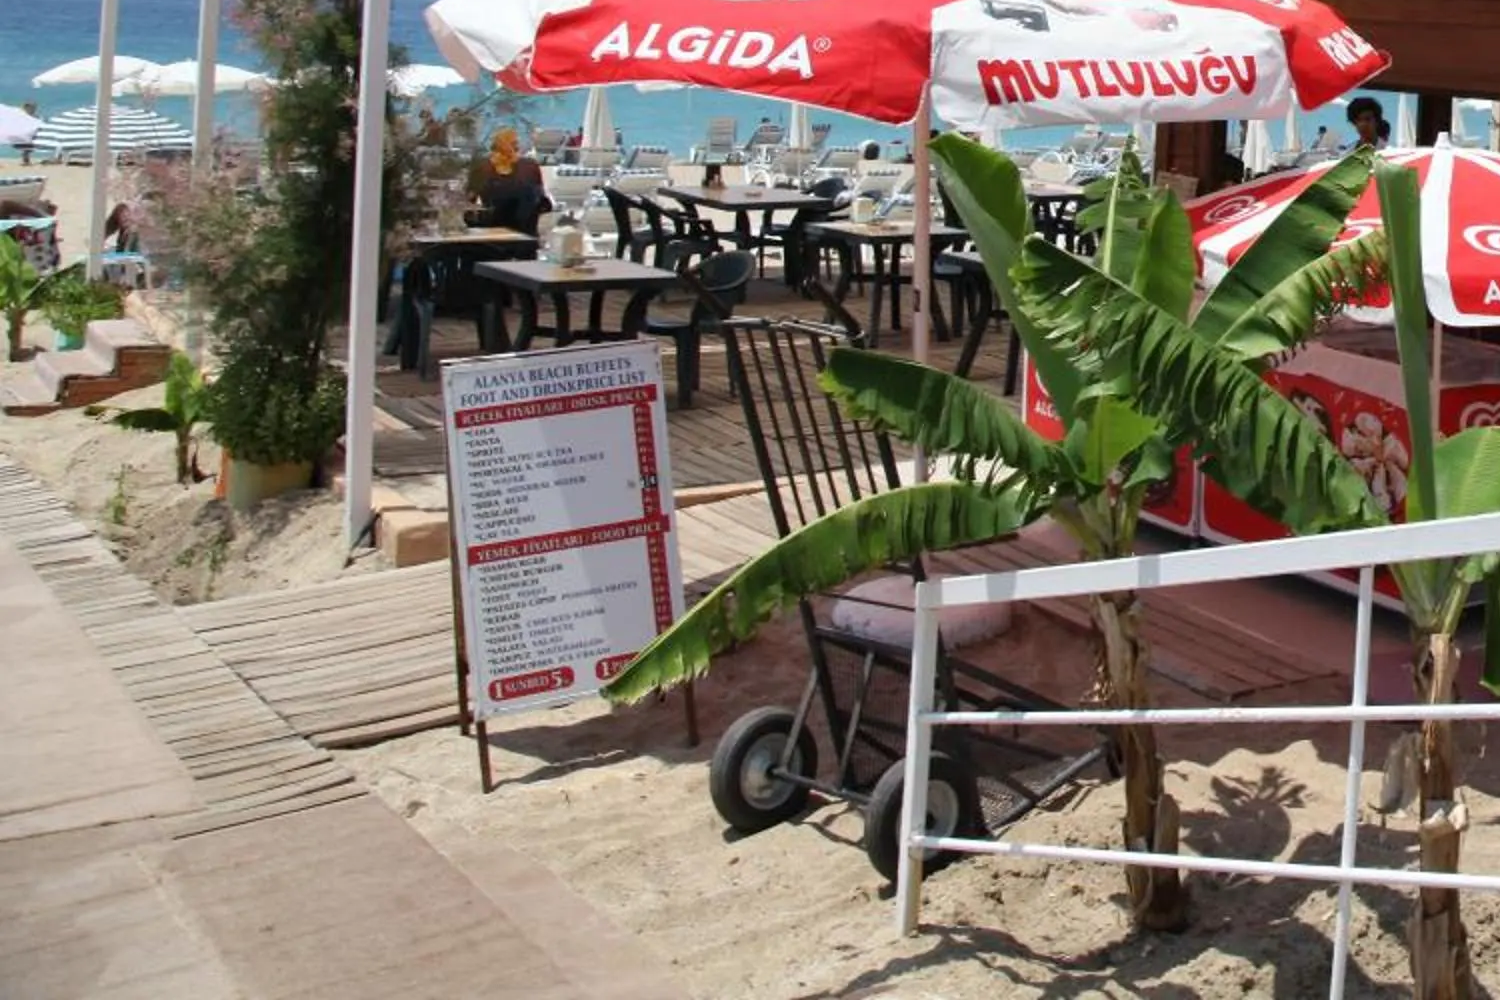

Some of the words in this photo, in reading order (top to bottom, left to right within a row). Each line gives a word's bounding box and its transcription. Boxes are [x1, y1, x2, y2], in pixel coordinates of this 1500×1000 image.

[977, 47, 1257, 105] MUTLULUĞU
[474, 370, 526, 389] ALANYA
[529, 363, 573, 381] BEACH
[576, 356, 632, 375] BUFFETS
[501, 386, 529, 401] AND
[618, 369, 646, 385] LIST
[627, 520, 662, 535] PRICE
[551, 669, 563, 690] 5
